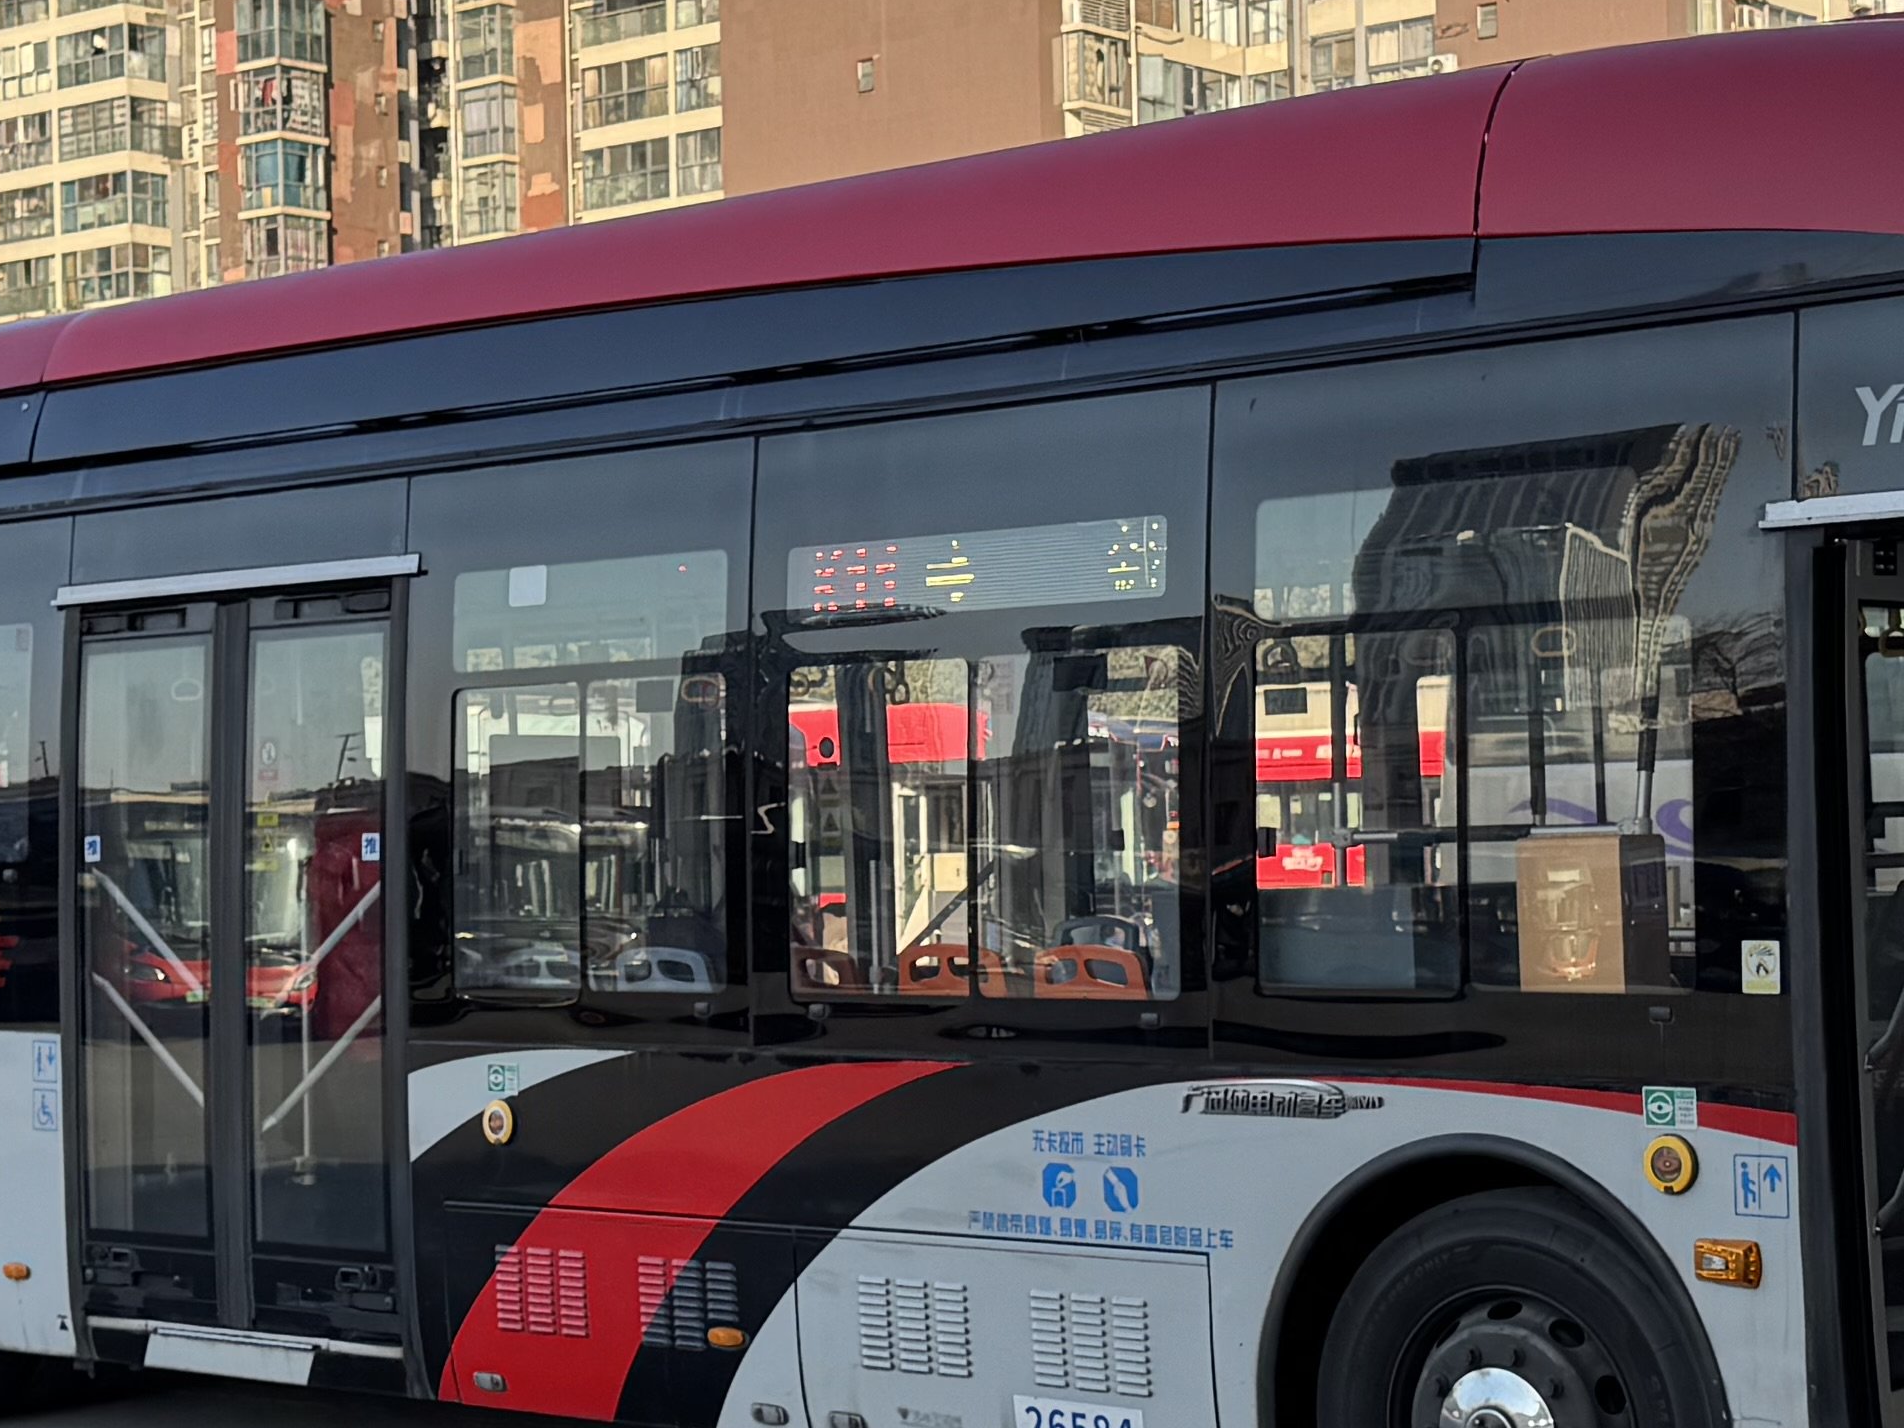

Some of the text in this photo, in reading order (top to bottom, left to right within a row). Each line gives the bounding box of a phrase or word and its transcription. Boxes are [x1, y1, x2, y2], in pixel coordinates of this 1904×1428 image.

[363, 836, 378, 855] 推
[1093, 1132, 1147, 1158] 主动刷卡
